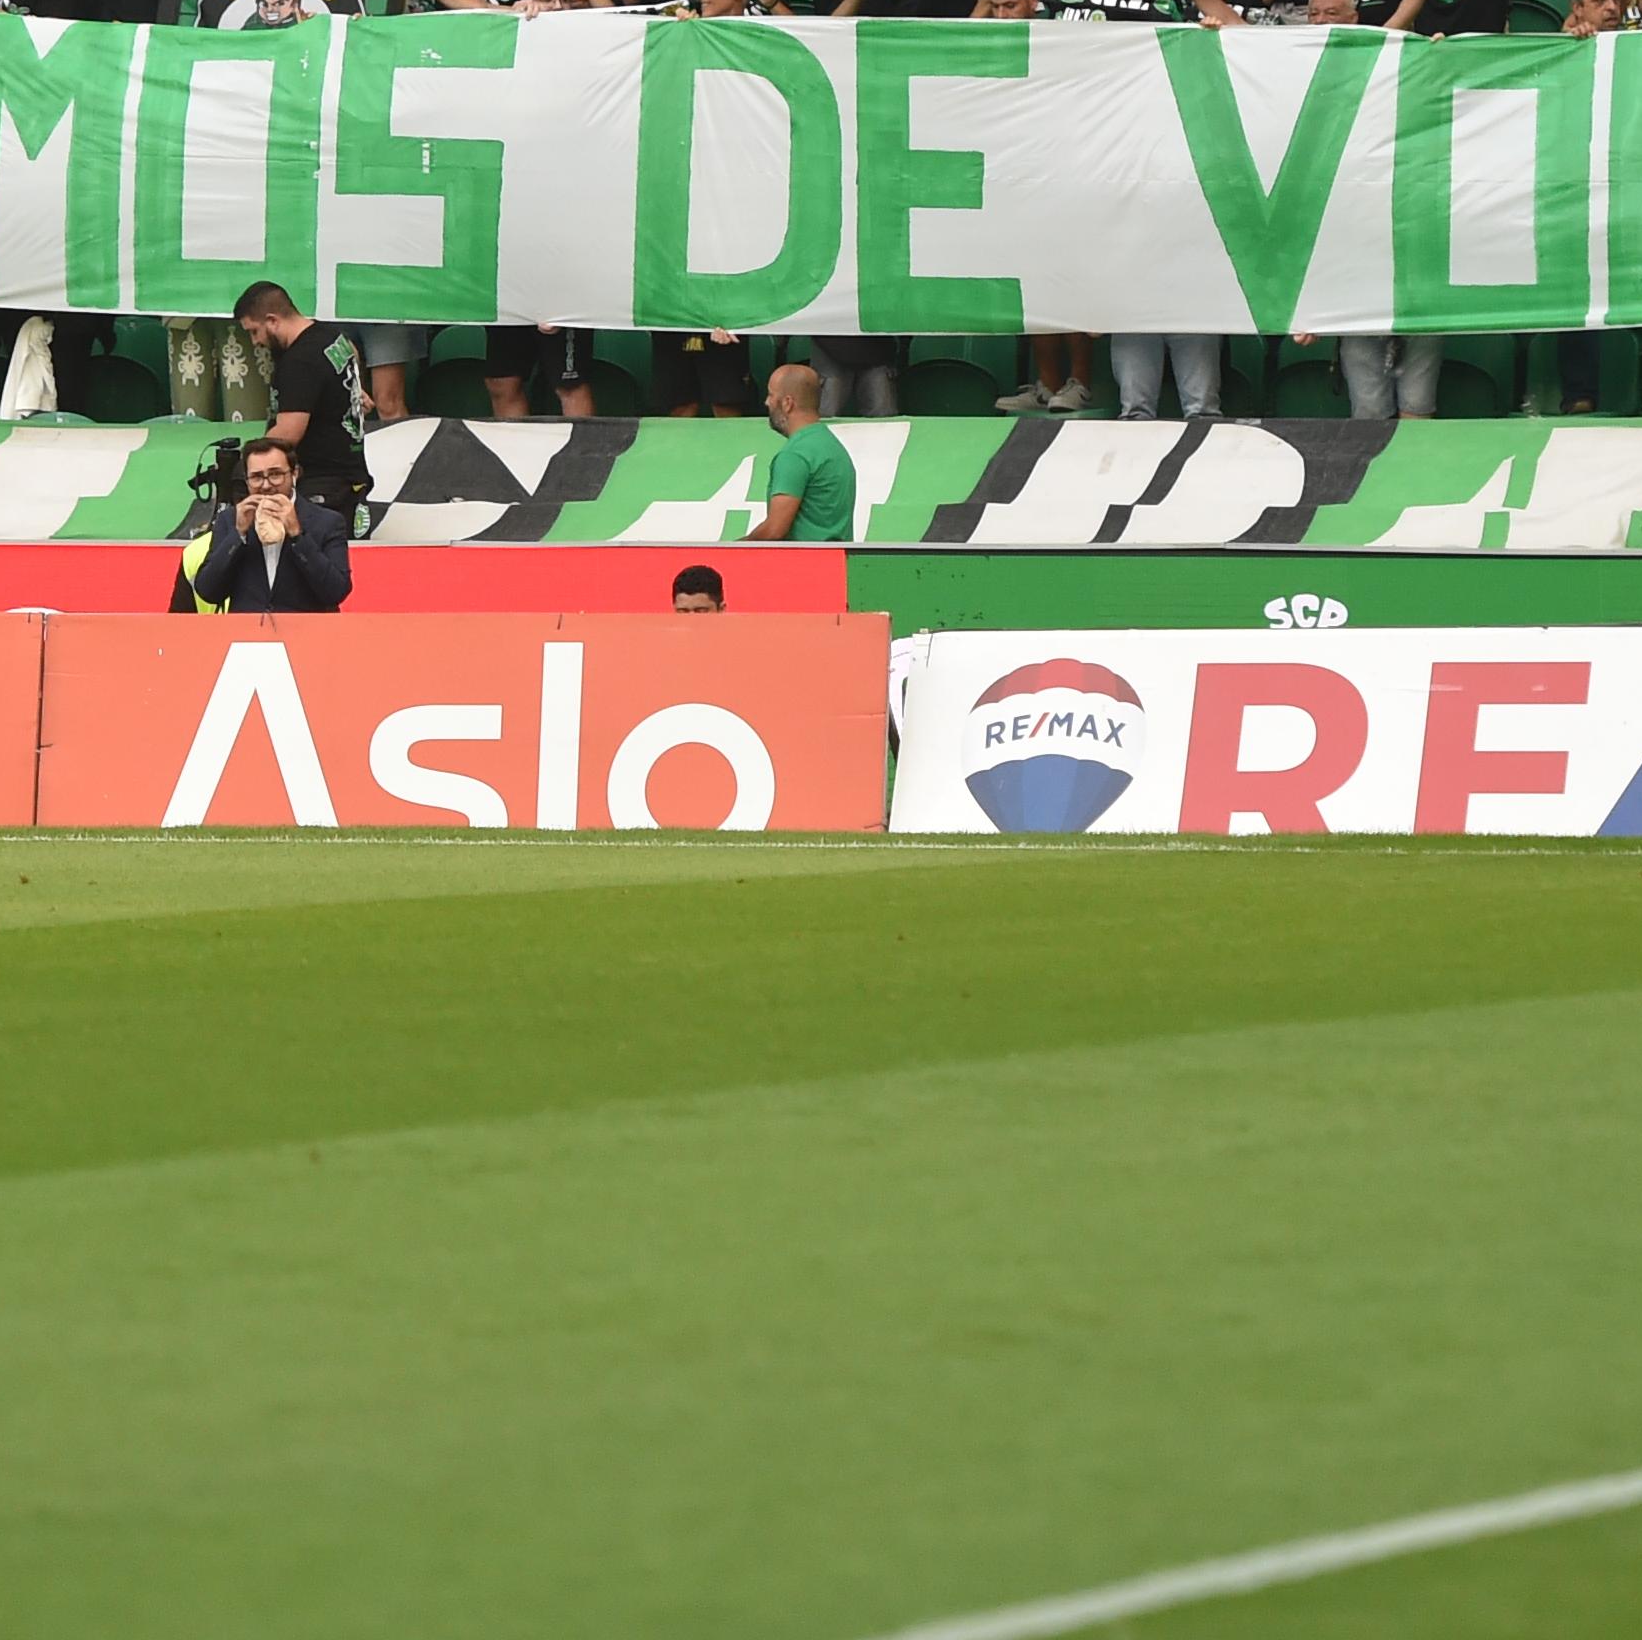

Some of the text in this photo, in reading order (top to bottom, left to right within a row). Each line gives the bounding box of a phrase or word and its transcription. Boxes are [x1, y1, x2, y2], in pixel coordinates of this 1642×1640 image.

[633, 17, 1030, 333] DE
[1262, 593, 1349, 630] SCP
[984, 711, 1127, 750] RE/MAX
